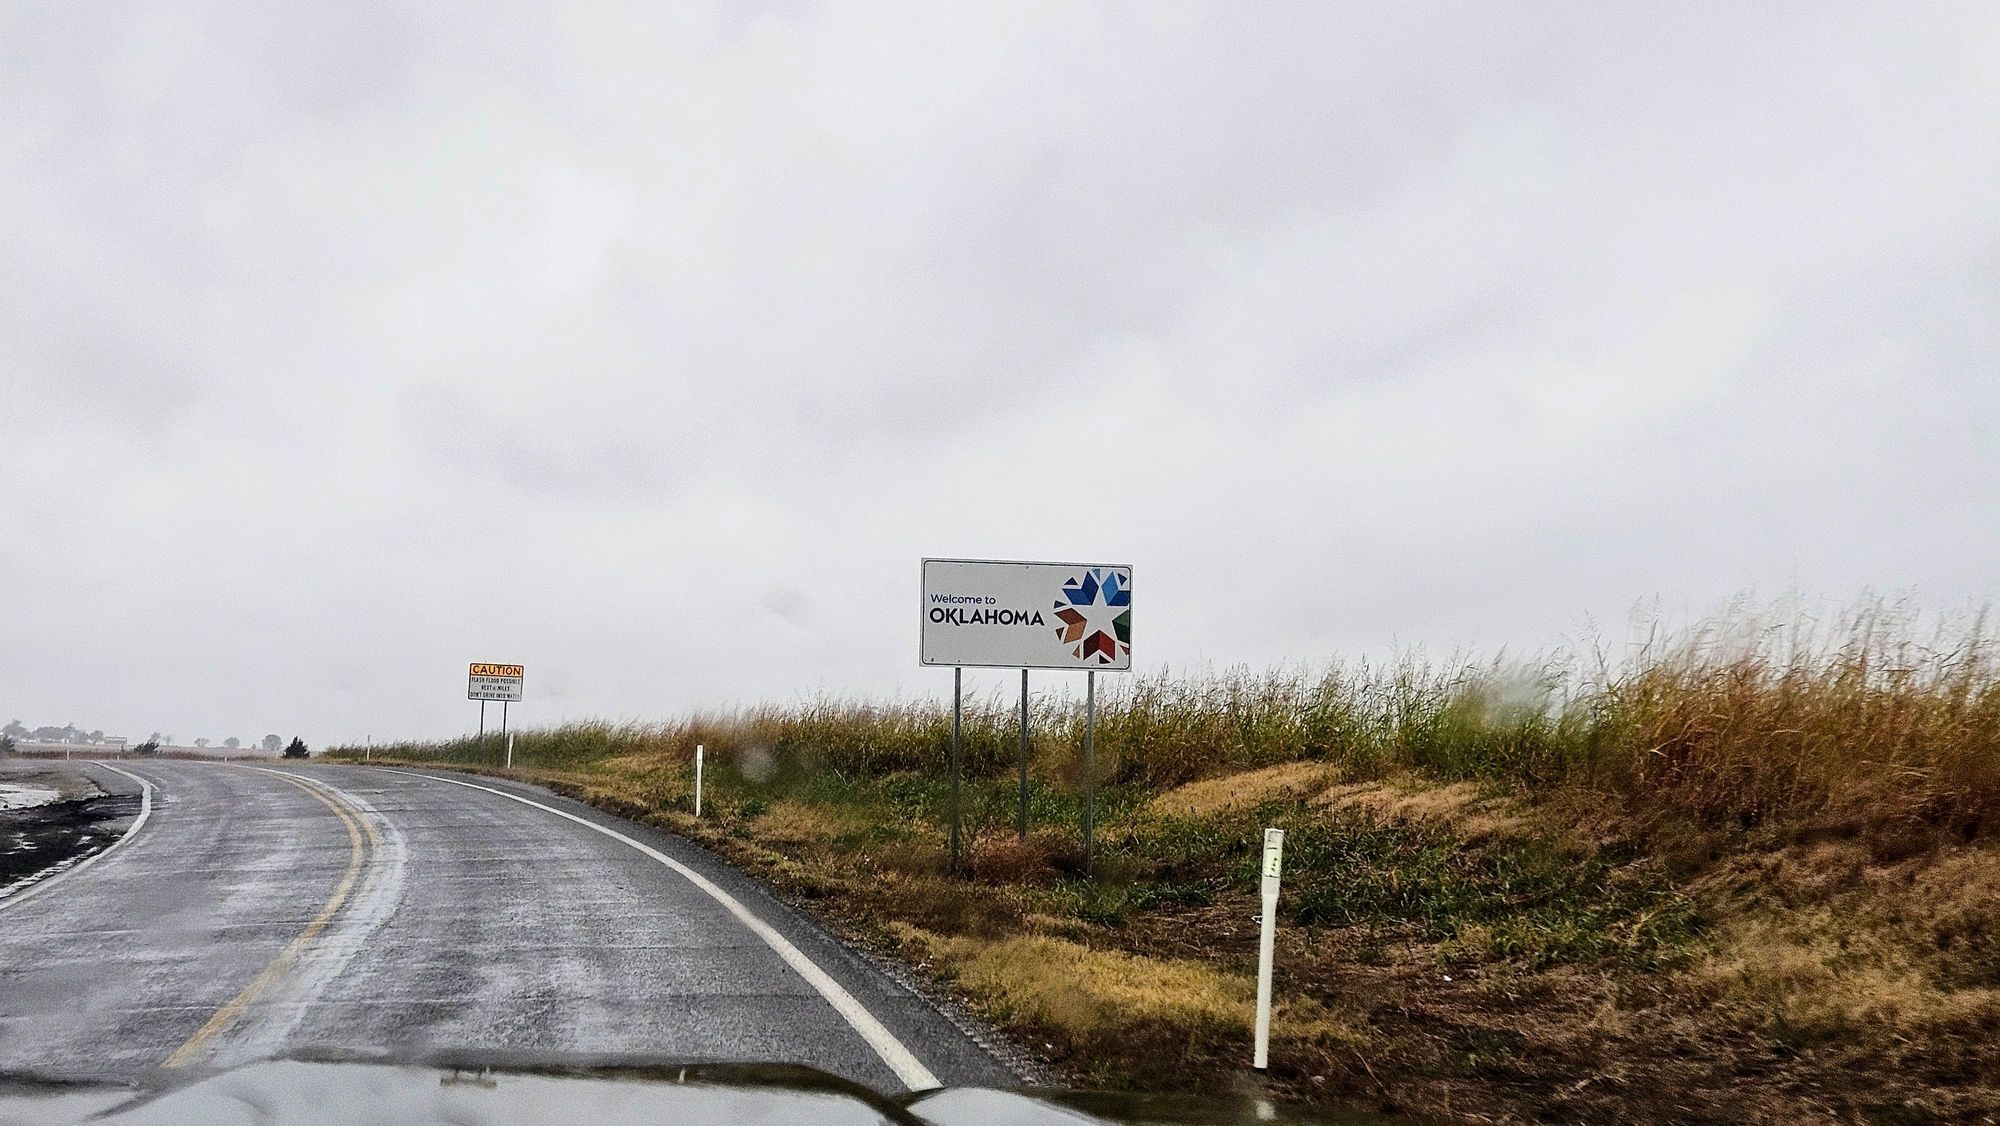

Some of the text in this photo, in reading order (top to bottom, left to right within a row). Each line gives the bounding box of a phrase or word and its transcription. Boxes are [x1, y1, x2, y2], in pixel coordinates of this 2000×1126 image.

[930, 594, 997, 605] Welcome to
[929, 607, 1045, 627] OKLAHOMA
[473, 665, 521, 675] CAUTION
